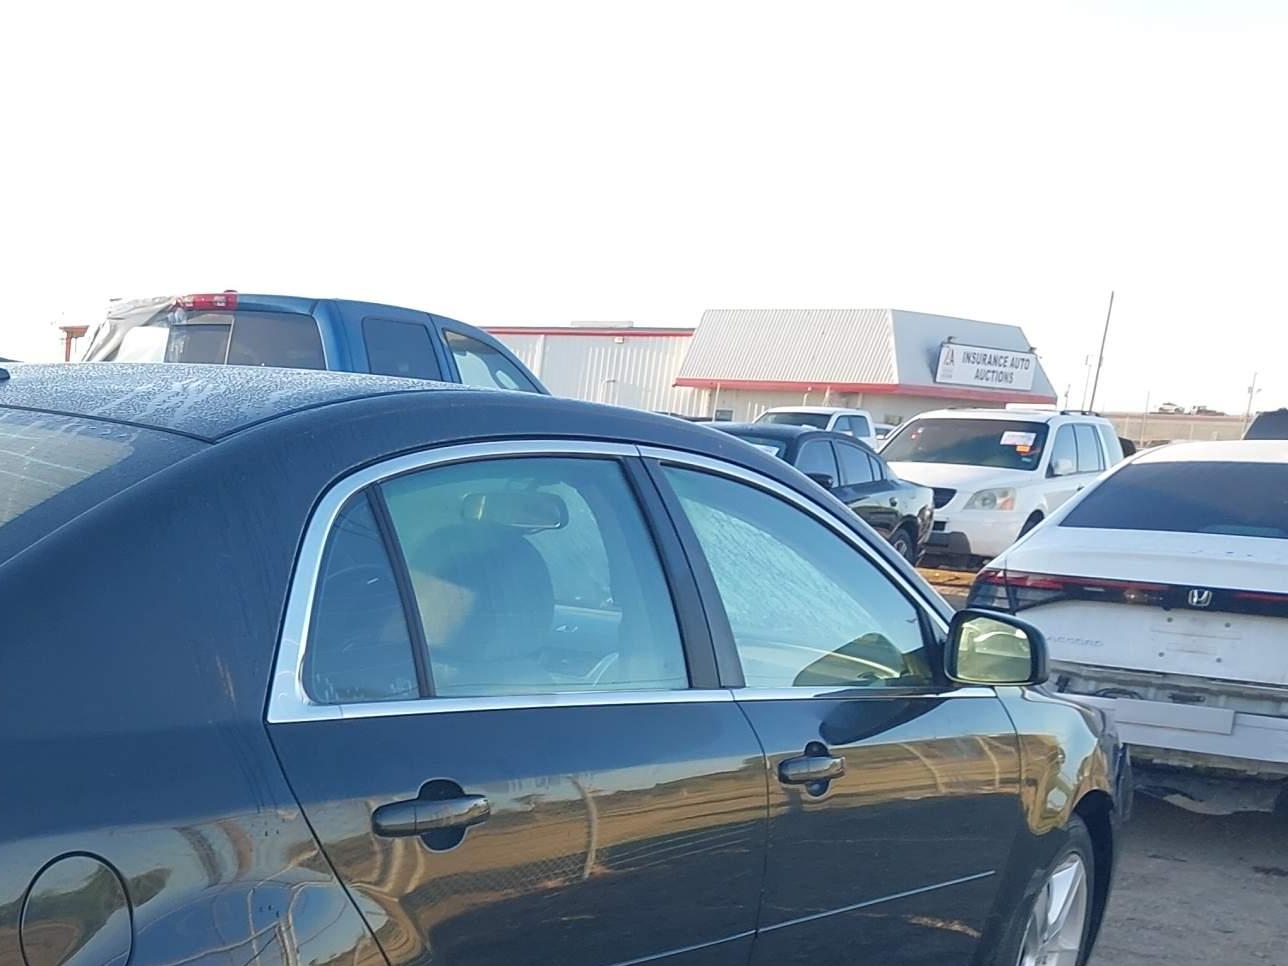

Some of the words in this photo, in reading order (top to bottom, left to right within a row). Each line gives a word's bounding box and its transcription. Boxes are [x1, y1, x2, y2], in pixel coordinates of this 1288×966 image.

[962, 351, 1009, 368] INSURANCE
[1010, 356, 1031, 370] AUTO
[974, 368, 1014, 384] AUCTIONS
